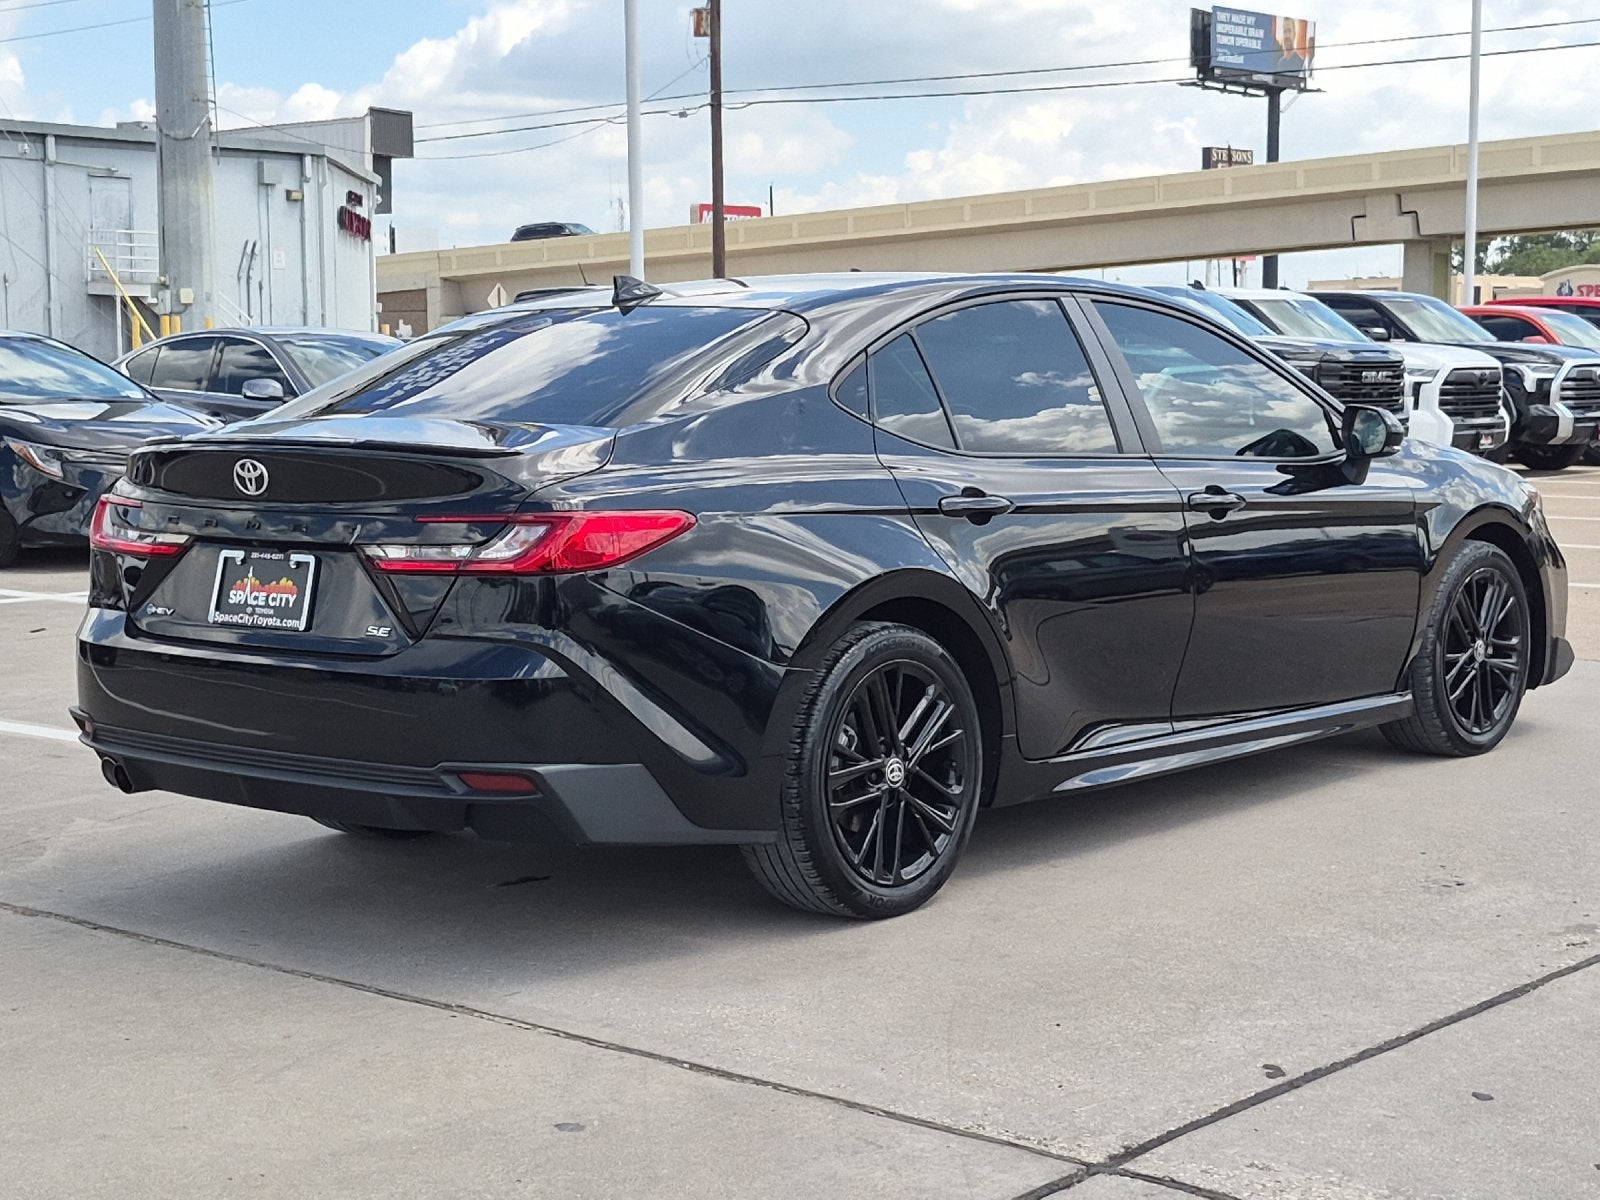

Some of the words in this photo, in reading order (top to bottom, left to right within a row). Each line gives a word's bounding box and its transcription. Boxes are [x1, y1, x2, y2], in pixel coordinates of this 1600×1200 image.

[1212, 149, 1252, 163] STESONS
[1362, 371, 1392, 383] GMC
[228, 590, 267, 605] SPACE
[268, 593, 297, 608] CITY
[214, 611, 300, 628] SpaceCityToyota.com
[366, 625, 391, 637] SE
